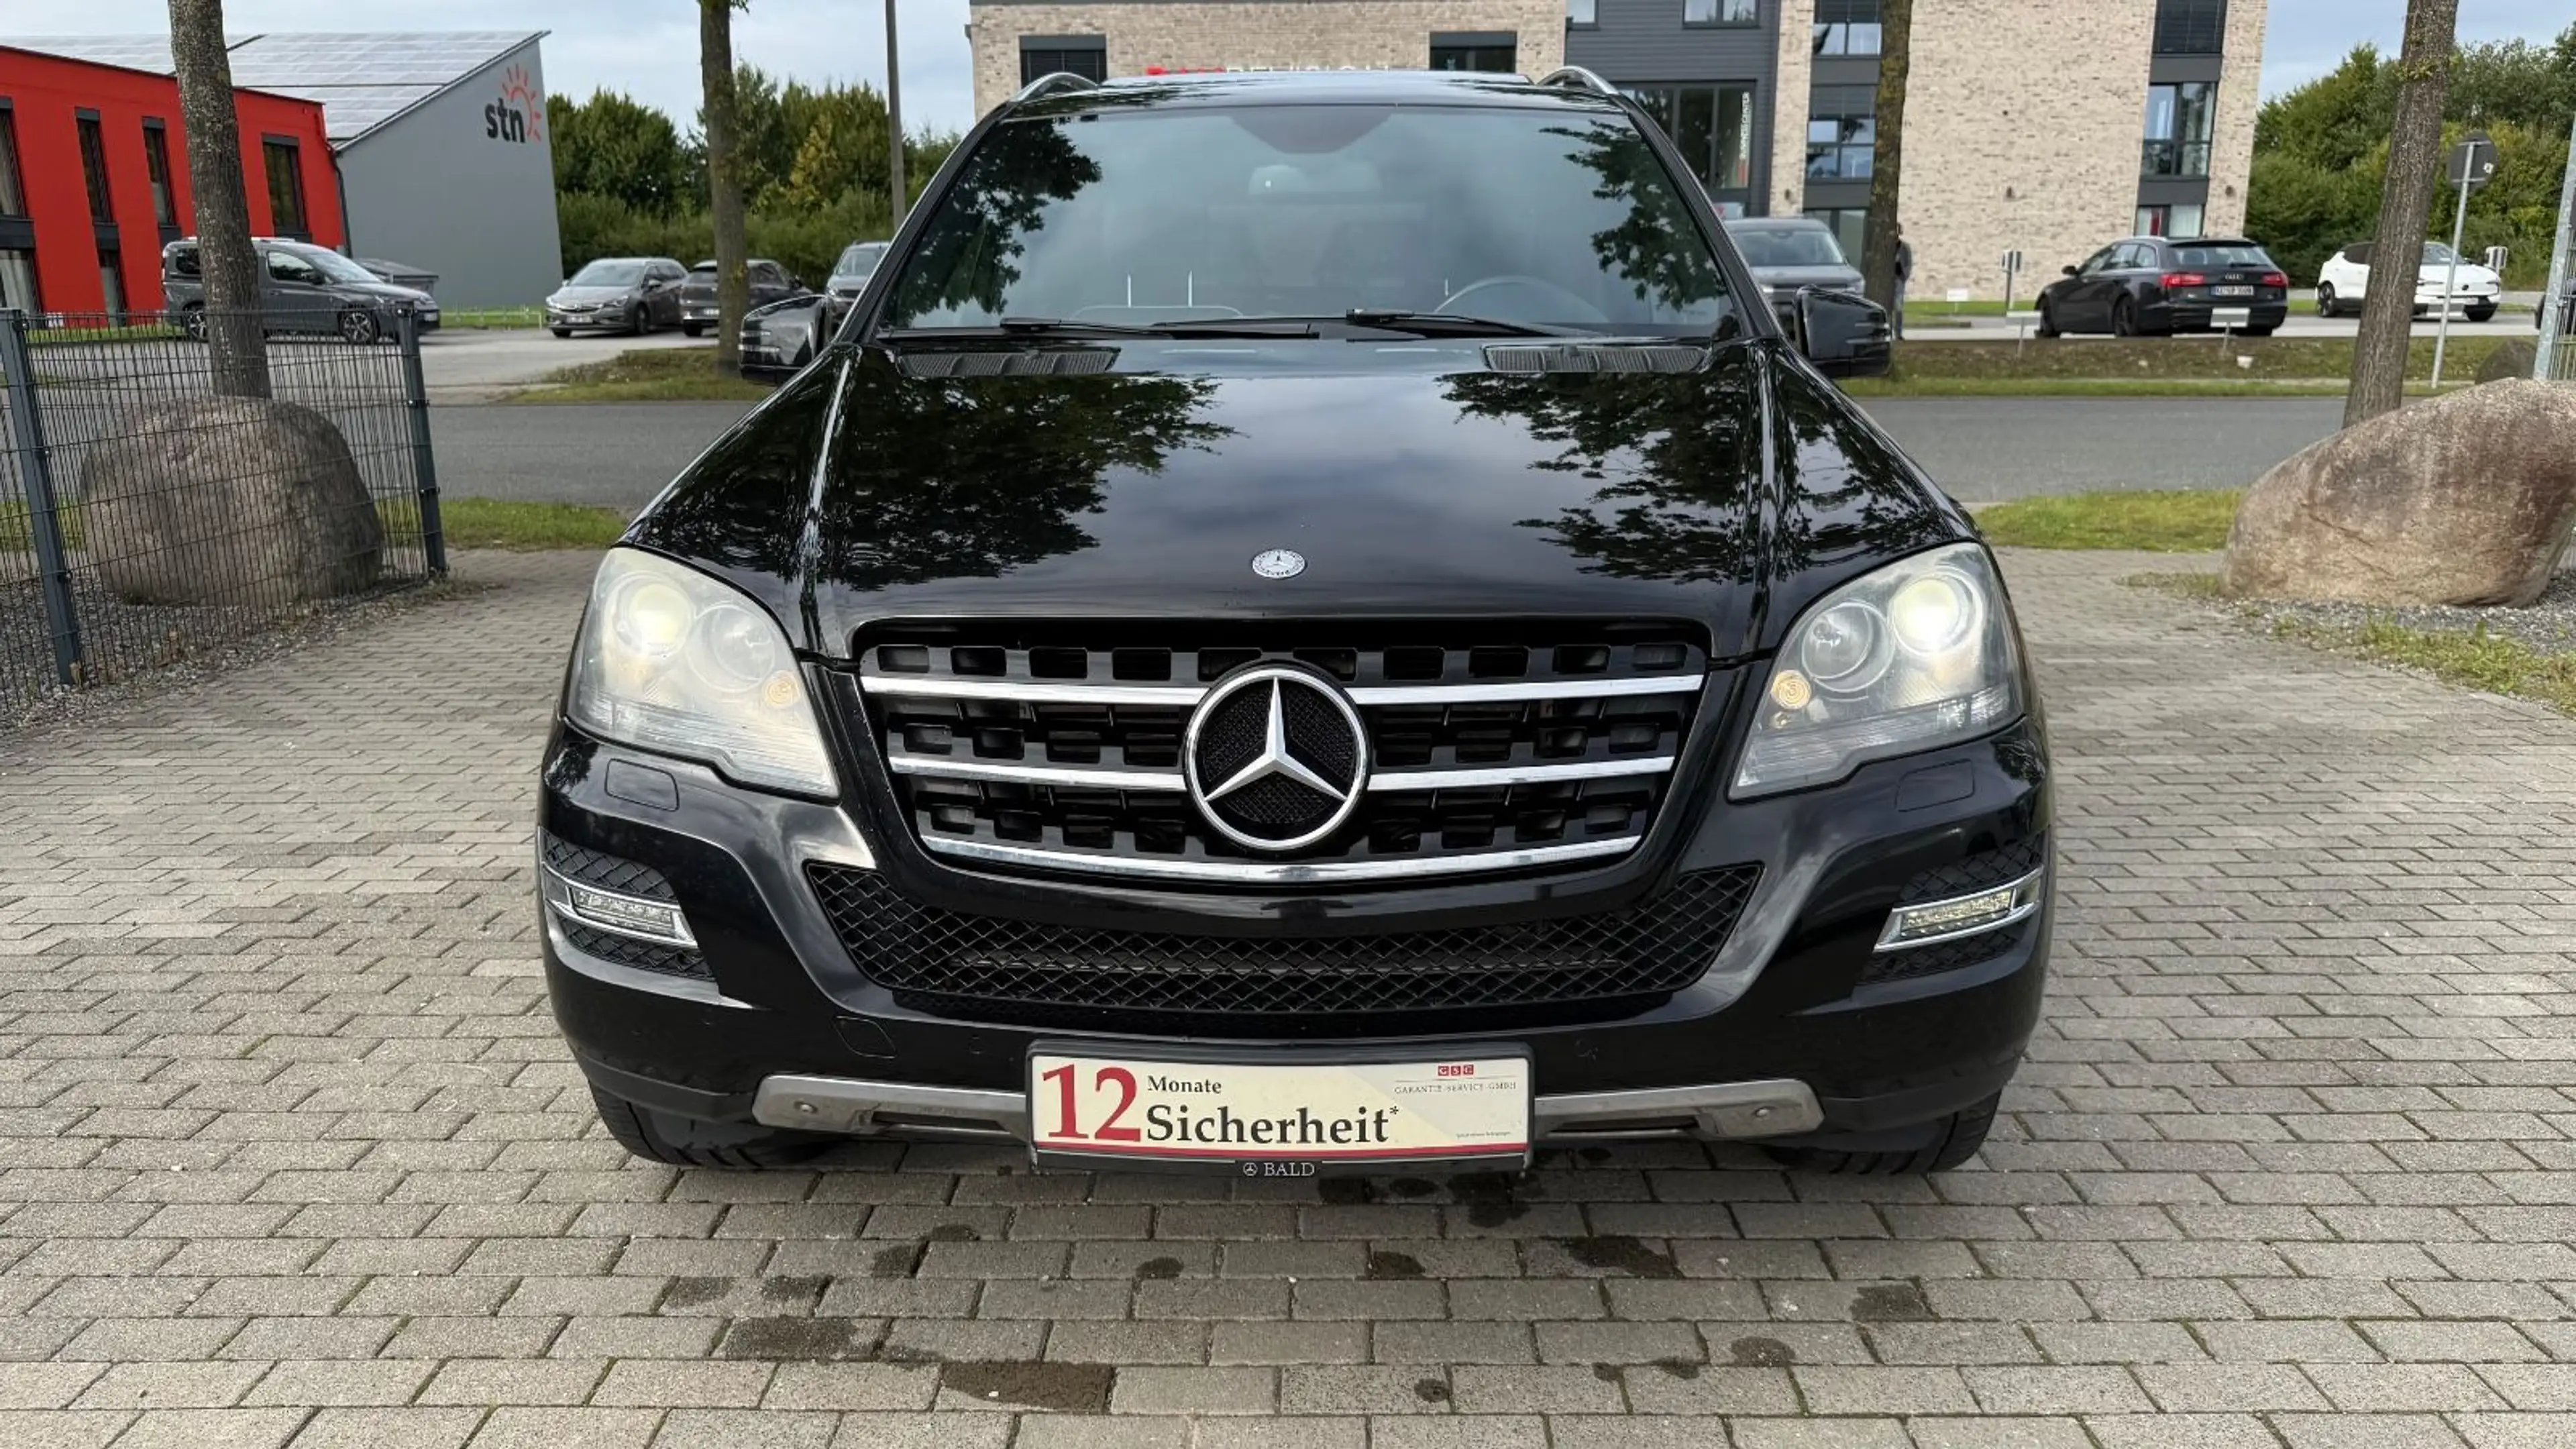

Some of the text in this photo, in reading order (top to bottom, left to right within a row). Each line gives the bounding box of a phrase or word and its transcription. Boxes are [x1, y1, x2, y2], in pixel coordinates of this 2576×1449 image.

[485, 97, 525, 143] stn
[1147, 1075, 1222, 1093] Monate
[1042, 1063, 1142, 1142] 12
[1263, 1162, 1315, 1177] BALD
